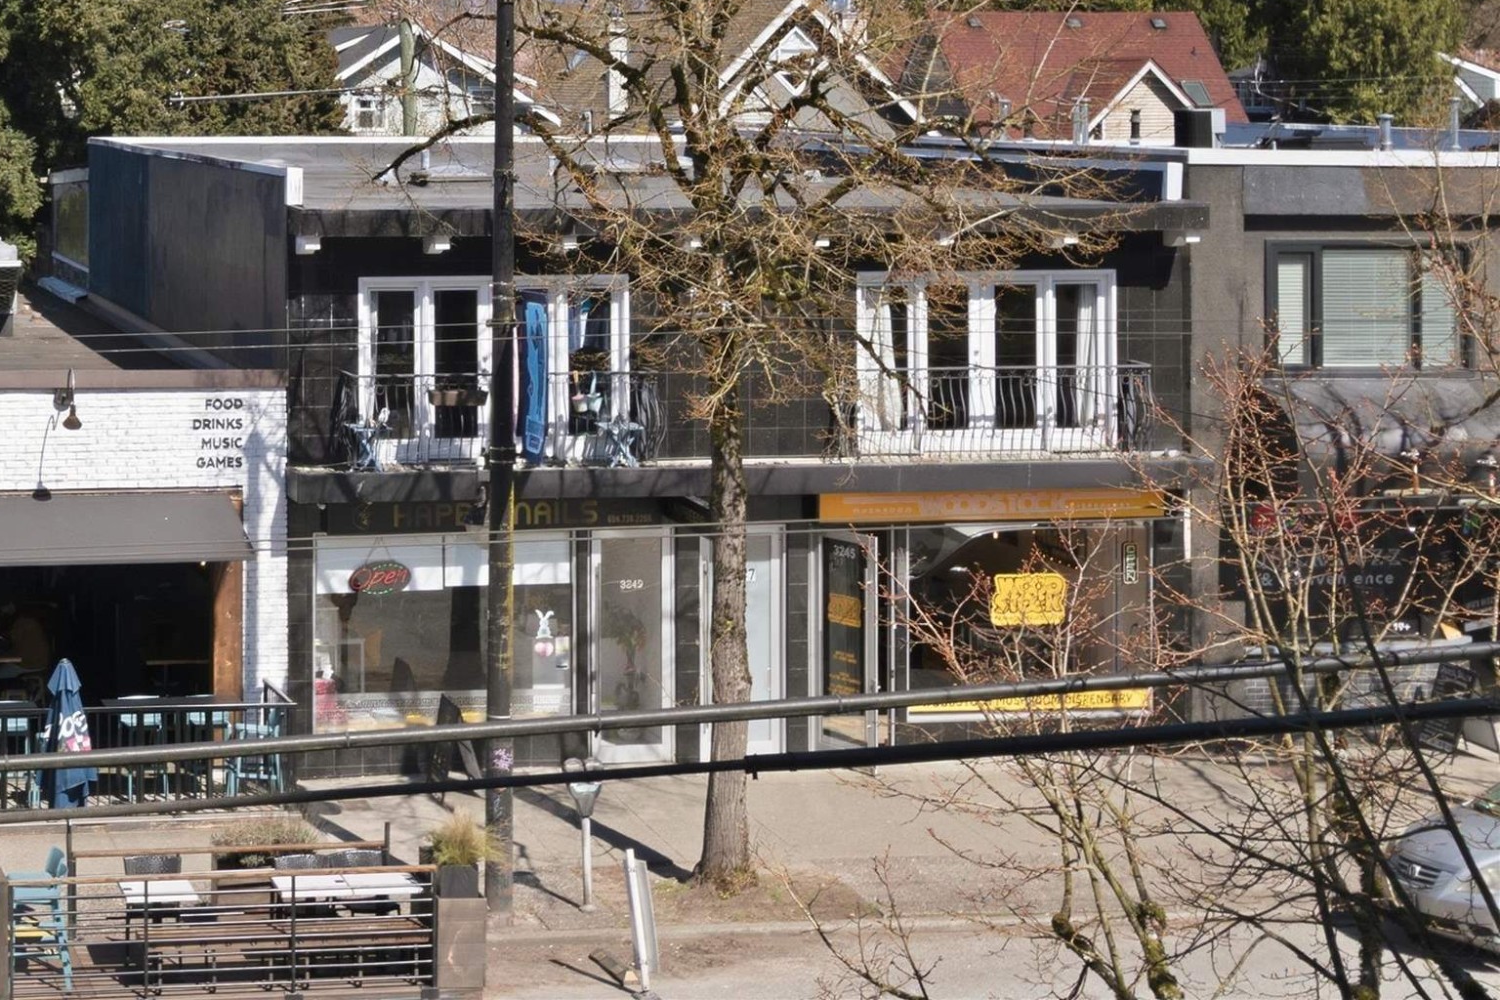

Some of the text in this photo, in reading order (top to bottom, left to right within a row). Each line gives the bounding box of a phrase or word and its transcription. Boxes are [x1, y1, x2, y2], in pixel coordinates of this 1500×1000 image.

[205, 398, 243, 411] FOOD
[192, 418, 243, 430] DRINKS
[201, 437, 243, 449] MUSIC
[196, 456, 243, 469] GAMES
[350, 567, 409, 590] Open
